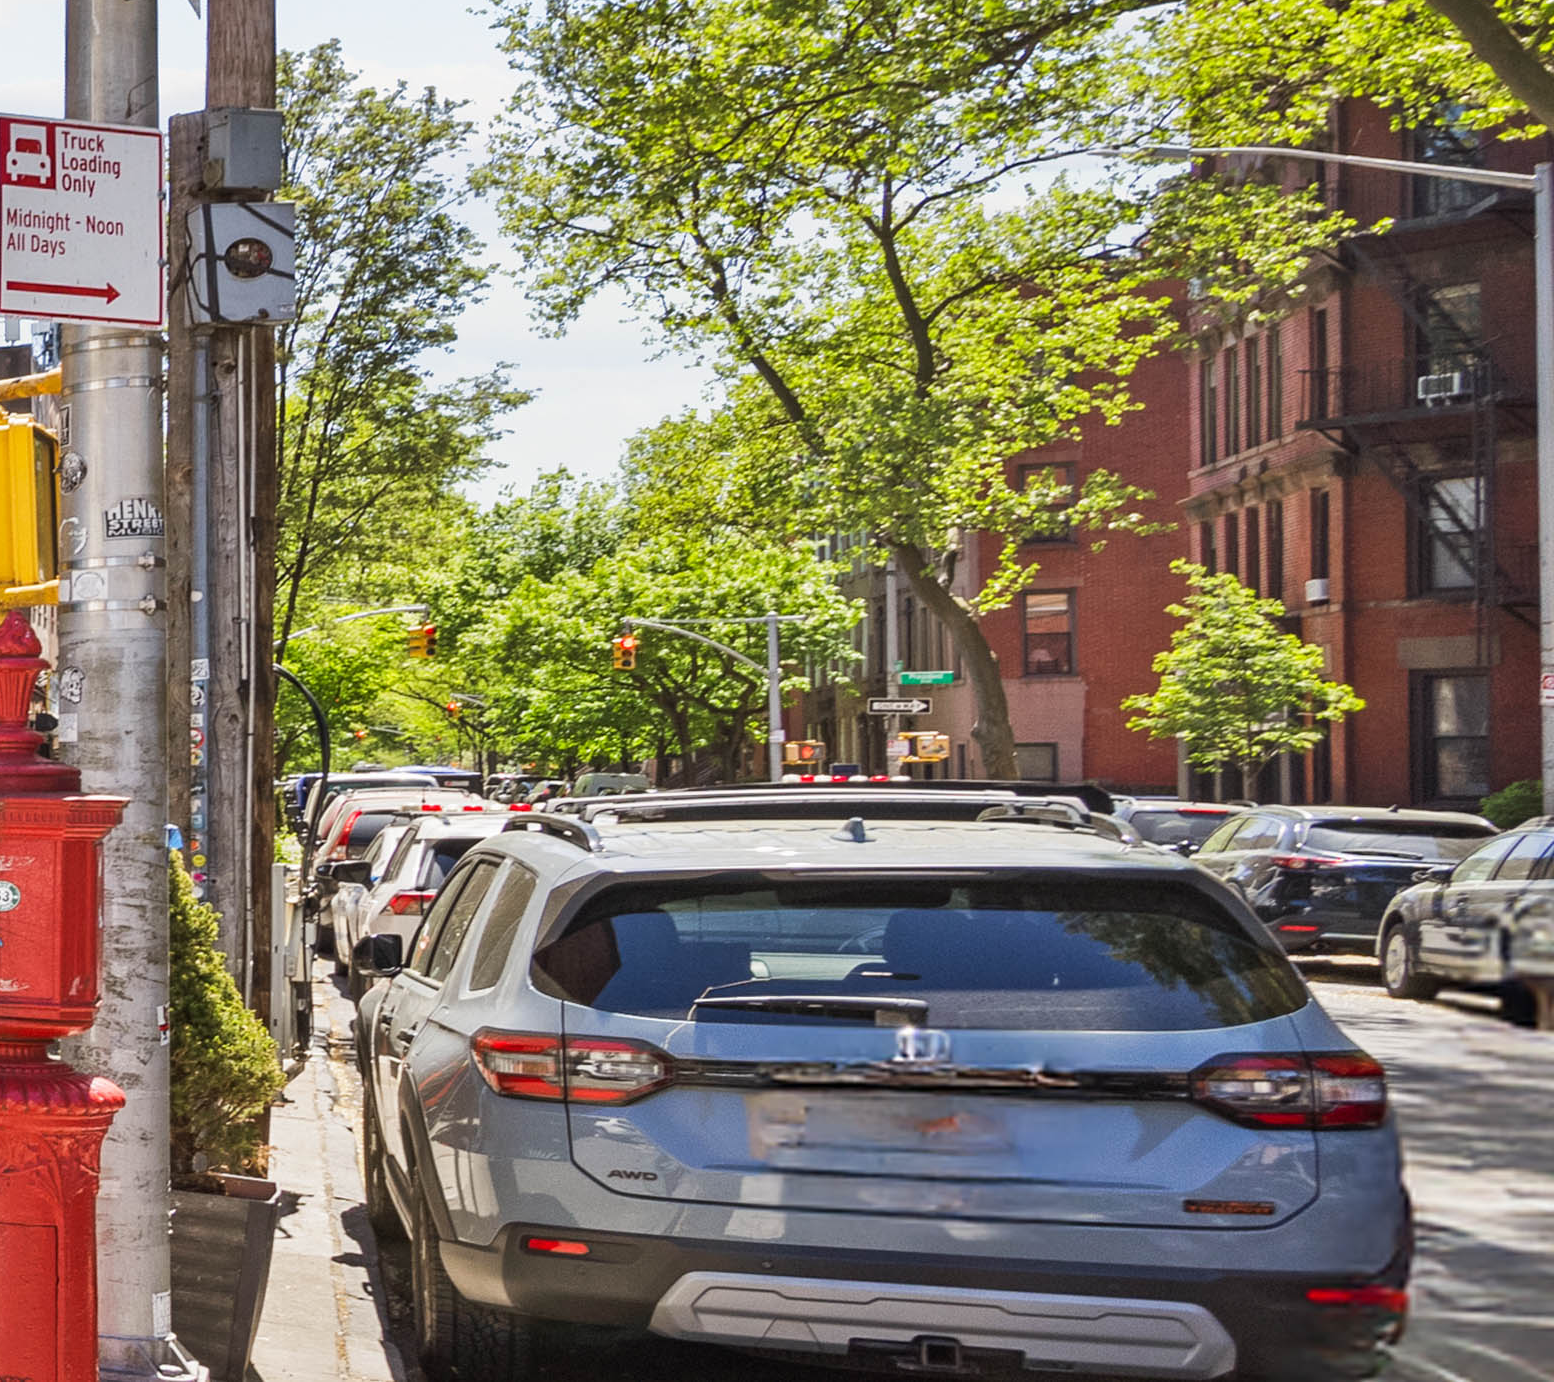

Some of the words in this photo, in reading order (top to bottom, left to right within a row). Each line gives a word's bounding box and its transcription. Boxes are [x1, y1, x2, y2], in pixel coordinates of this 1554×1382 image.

[61, 131, 105, 152] Truck
[61, 152, 121, 179] Loading
[61, 173, 96, 197] Only
[6, 208, 71, 234] Midnight
[86, 215, 124, 236] Noon
[6, 233, 25, 251] All
[31, 234, 66, 258] Days
[607, 1169, 658, 1181] AWD
